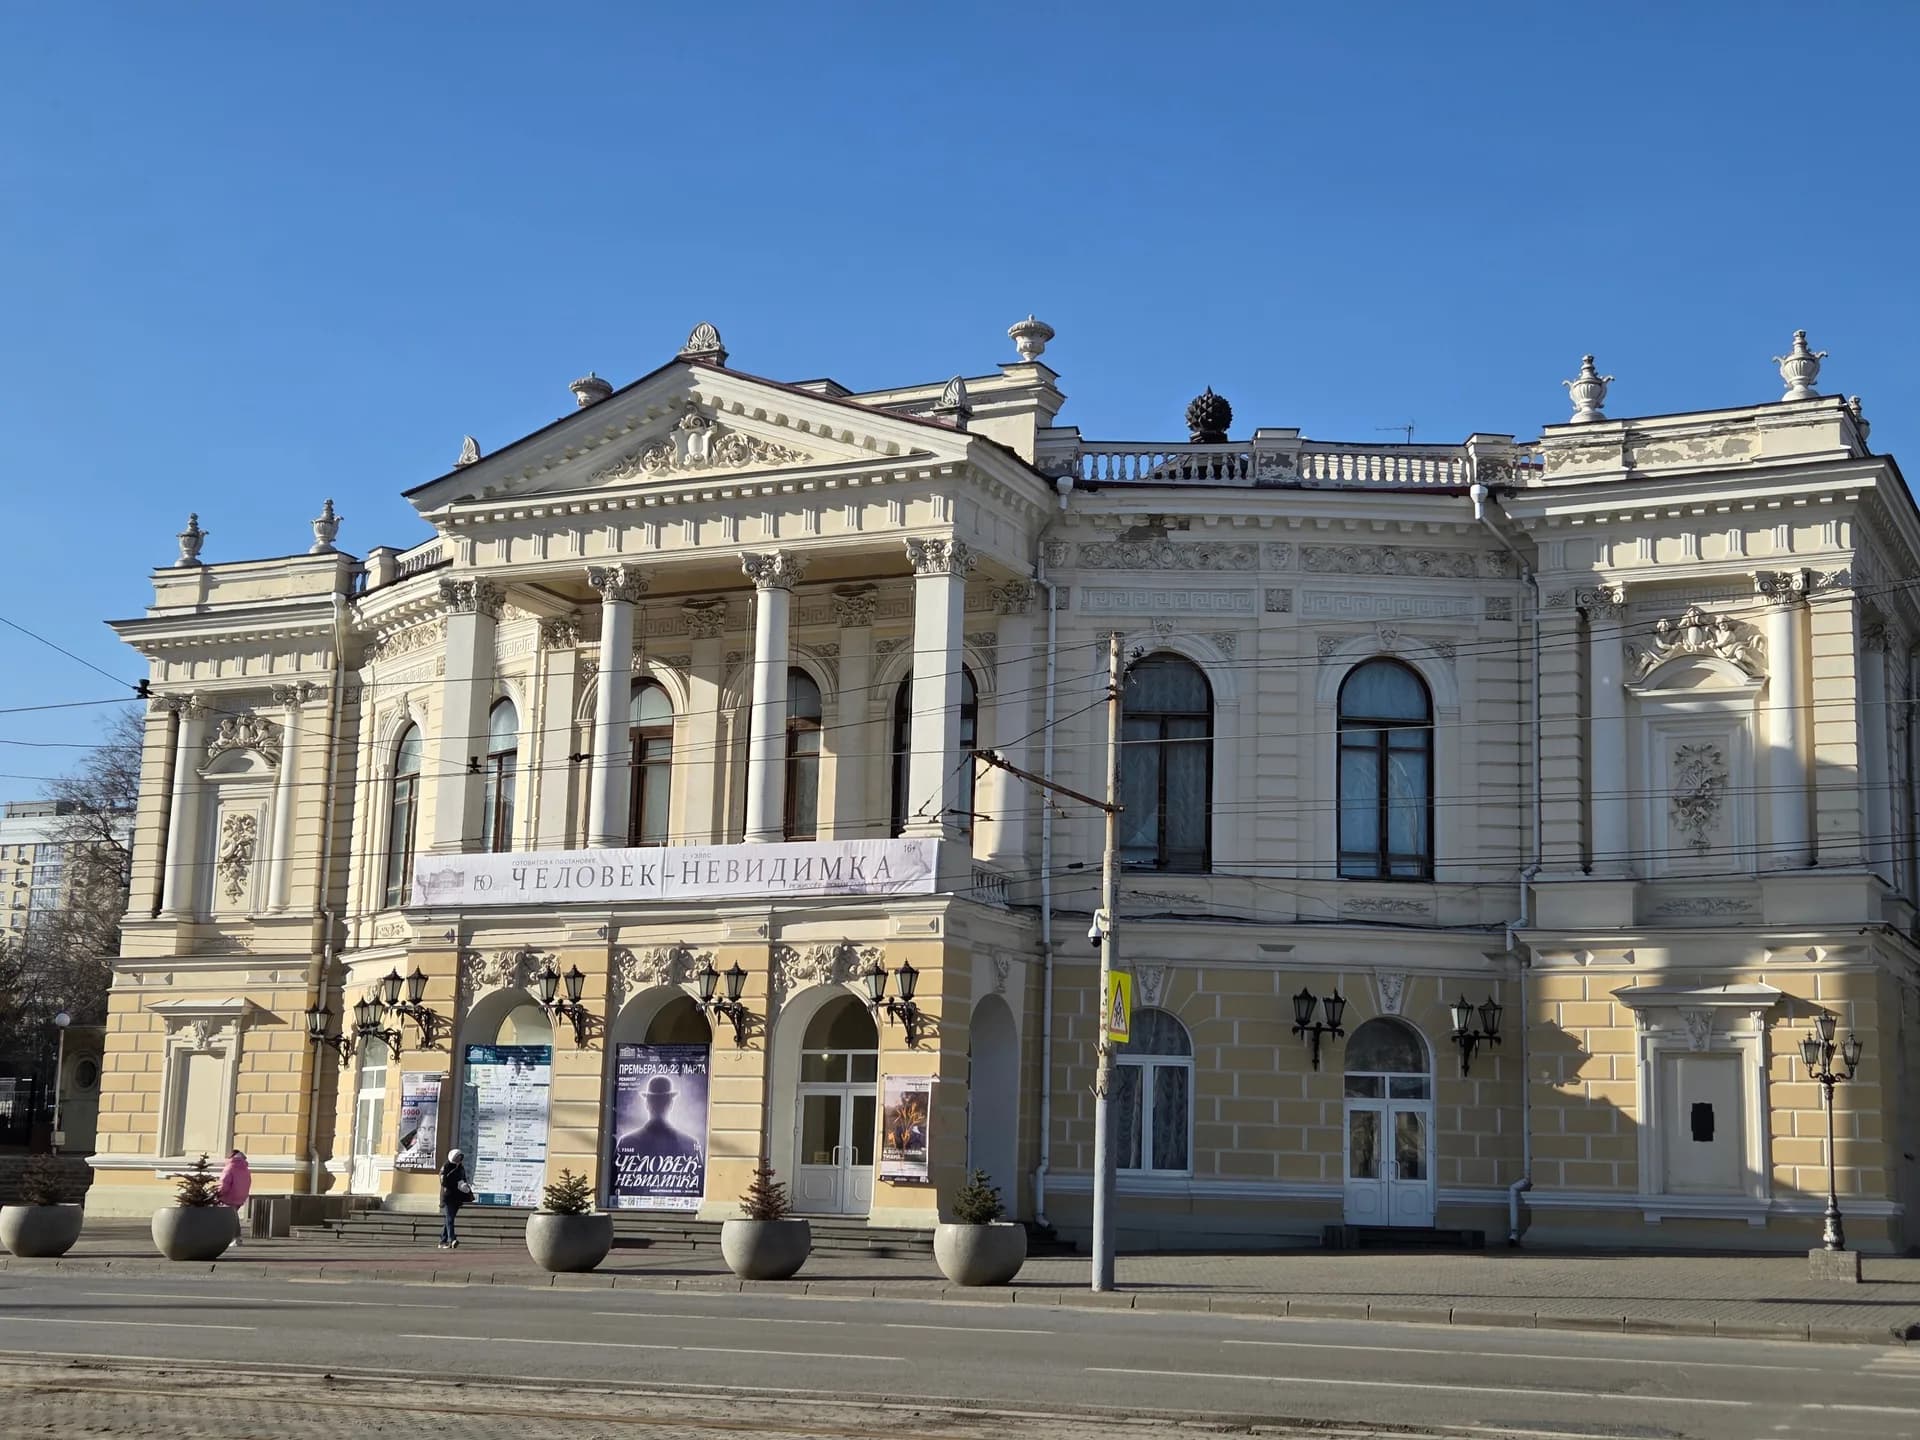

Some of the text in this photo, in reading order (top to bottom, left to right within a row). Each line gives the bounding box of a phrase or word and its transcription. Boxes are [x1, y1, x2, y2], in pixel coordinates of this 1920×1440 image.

[618, 1063, 706, 1075] ПРЕМЬЕРА 20-22 МАРТА
[615, 1153, 702, 1175] ЧЕЛОВЕК-
[615, 1173, 700, 1189] НЕВИДИМКА
